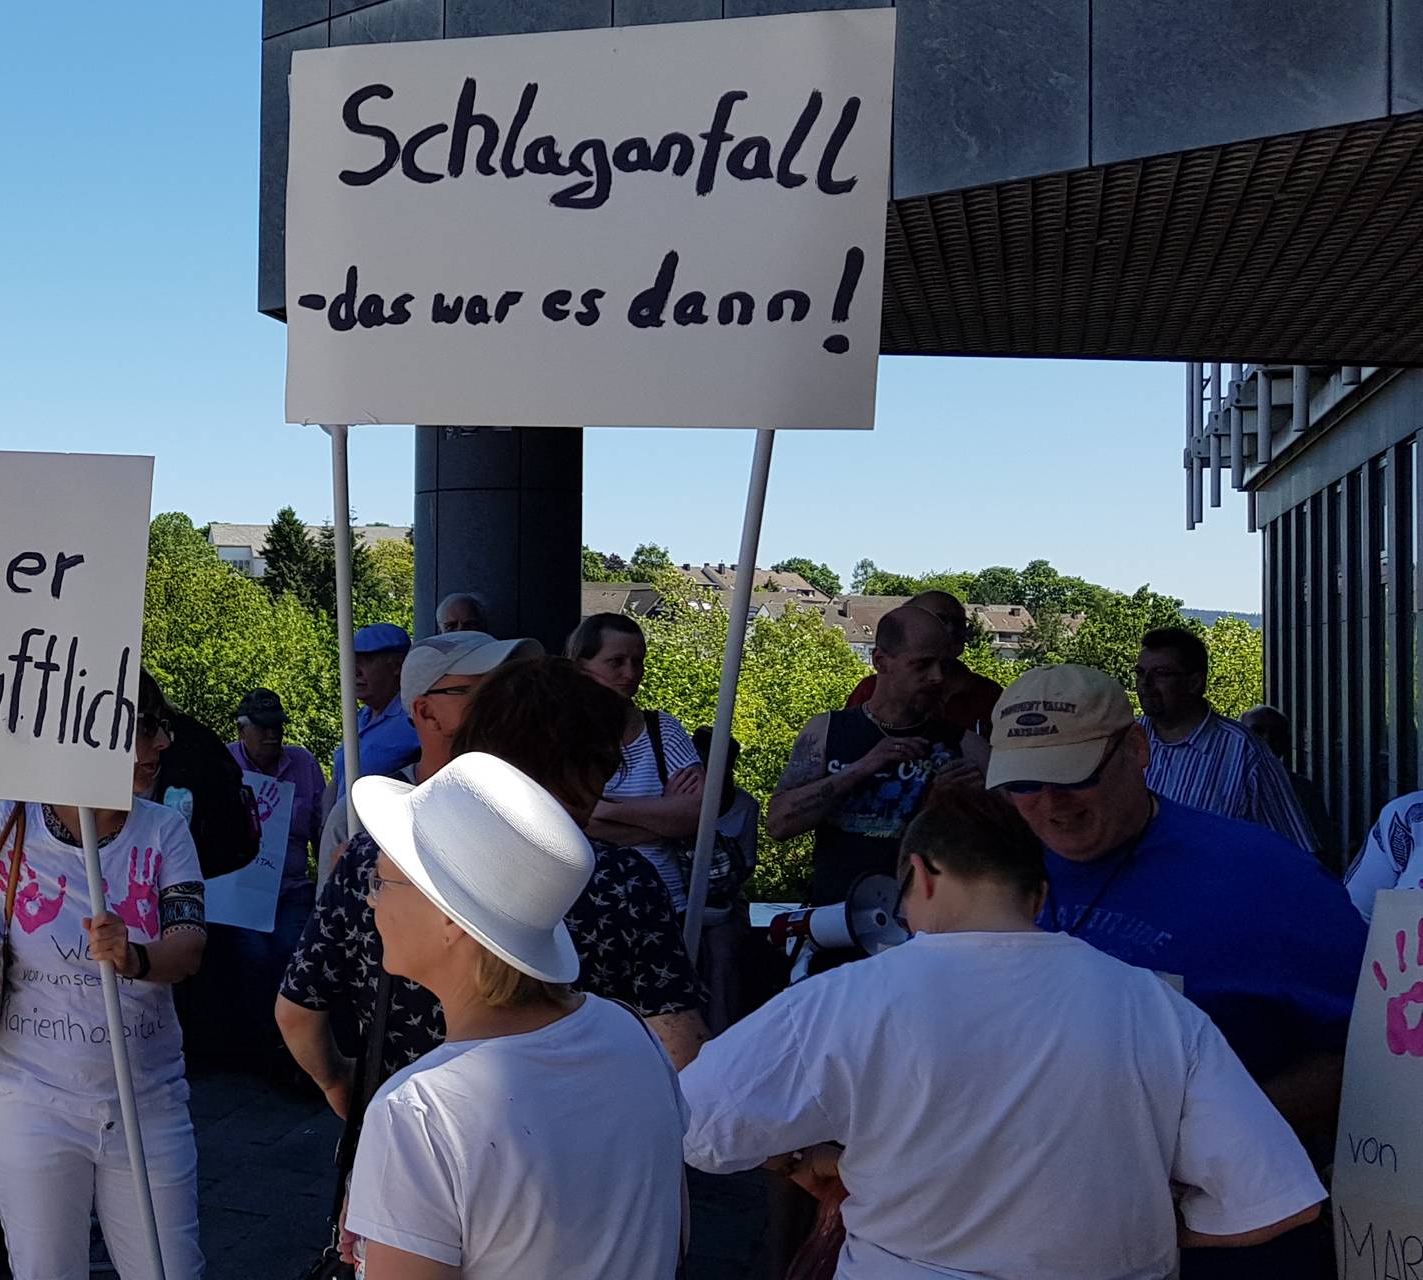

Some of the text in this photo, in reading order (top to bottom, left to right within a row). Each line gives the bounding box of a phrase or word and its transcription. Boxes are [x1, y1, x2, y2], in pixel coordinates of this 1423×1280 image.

[338, 76, 862, 209] Schlaganfall
[432, 290, 525, 326] war
[542, 287, 606, 328] es
[627, 246, 865, 354] dann!
[1348, 1132, 1397, 1173] von
